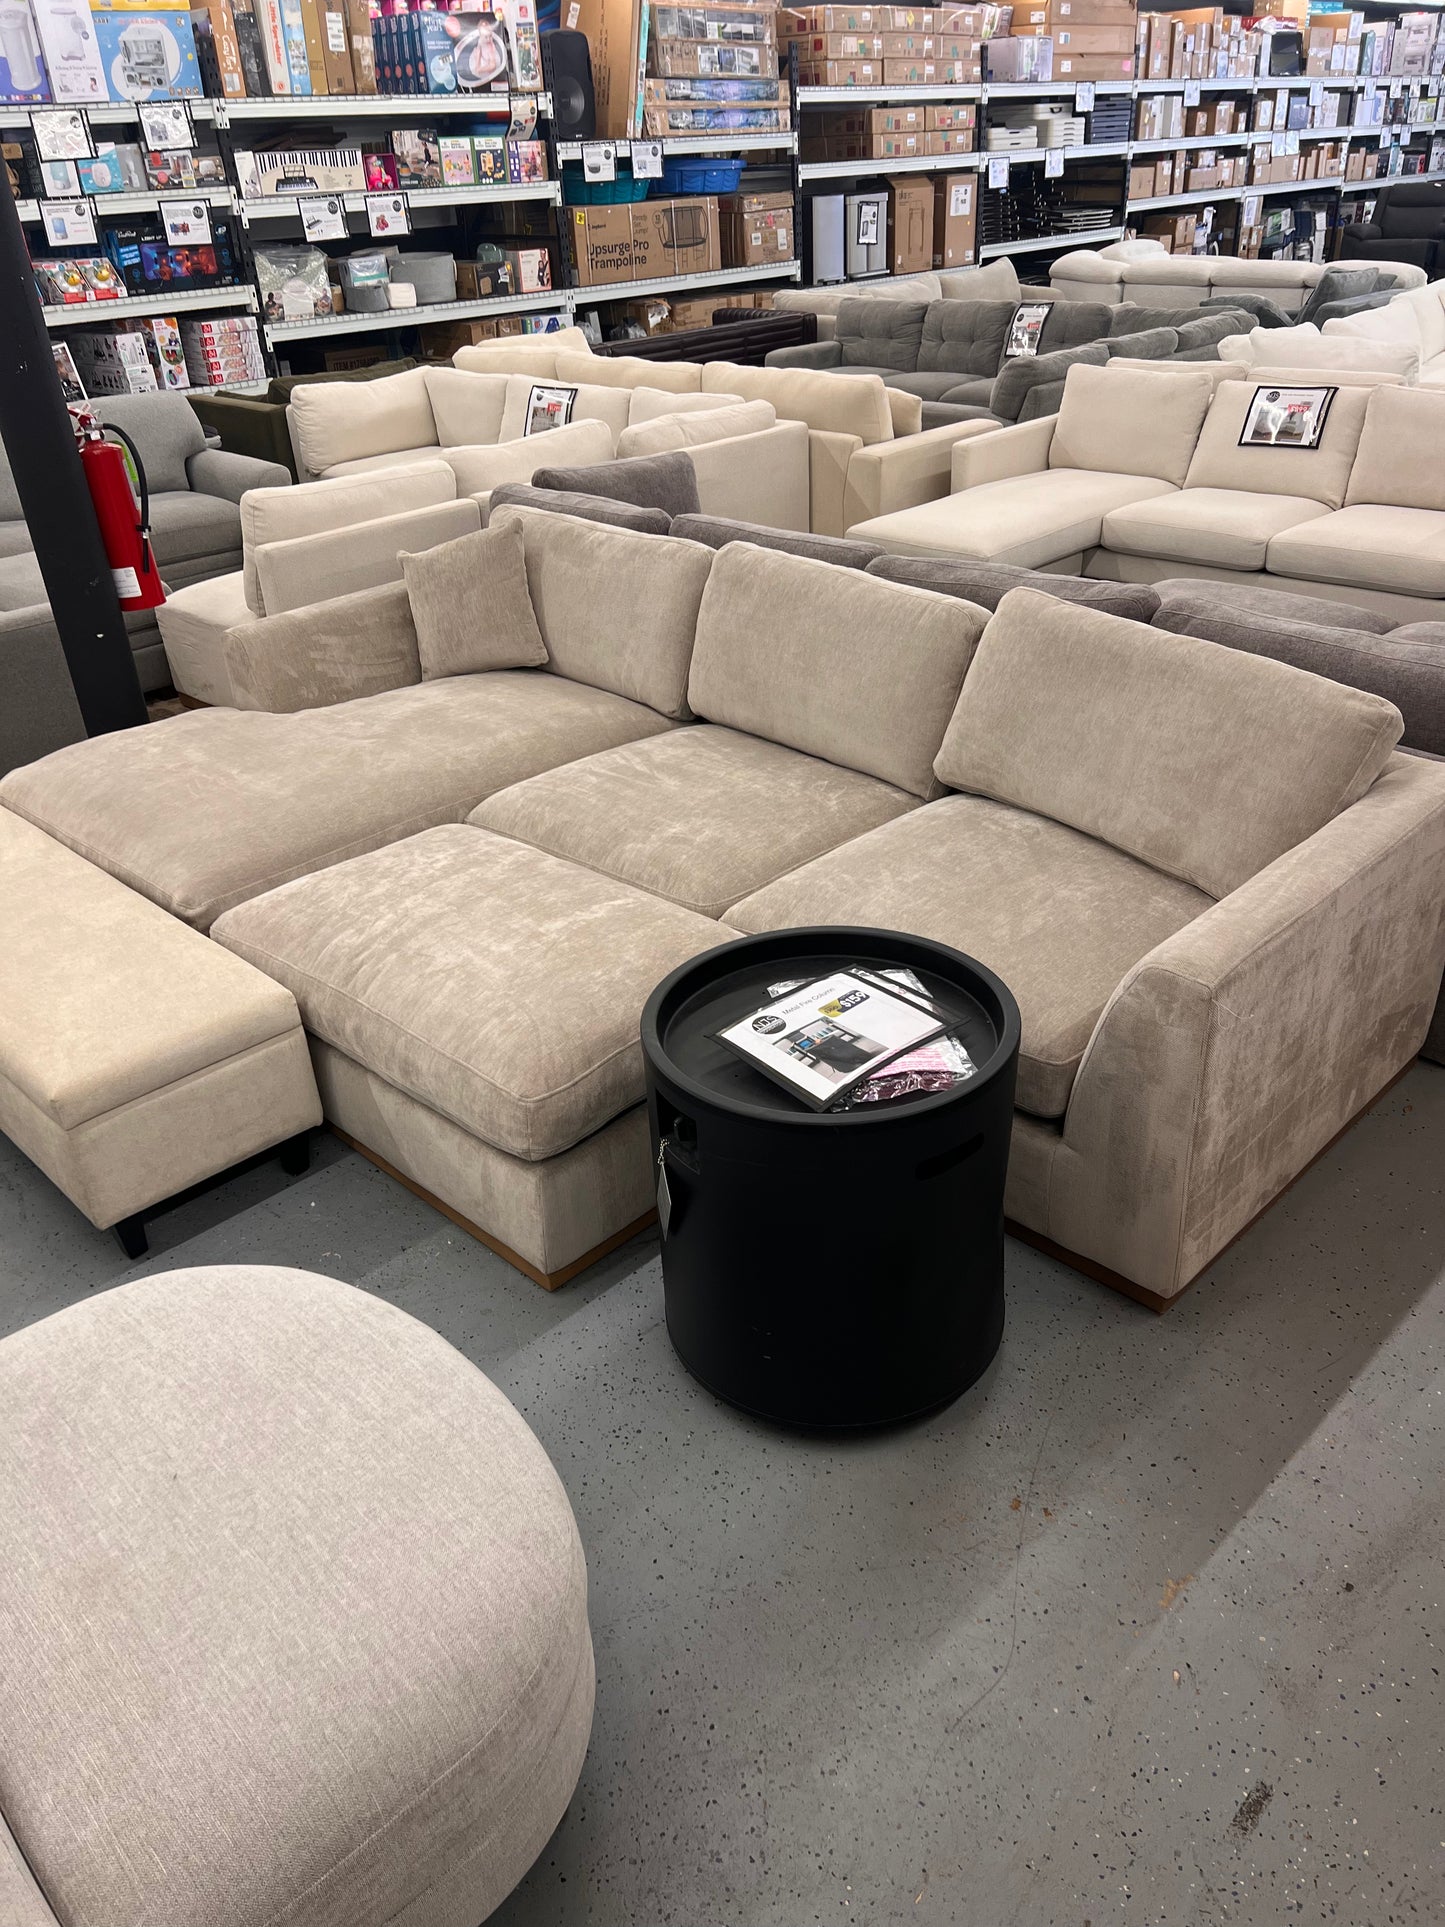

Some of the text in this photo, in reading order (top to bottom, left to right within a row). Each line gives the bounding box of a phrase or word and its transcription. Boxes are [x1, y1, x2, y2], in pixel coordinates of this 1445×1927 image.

[587, 240, 649, 257] Upsurge Pro
[588, 253, 647, 270] Trampoline
[840, 990, 867, 1009] $159
